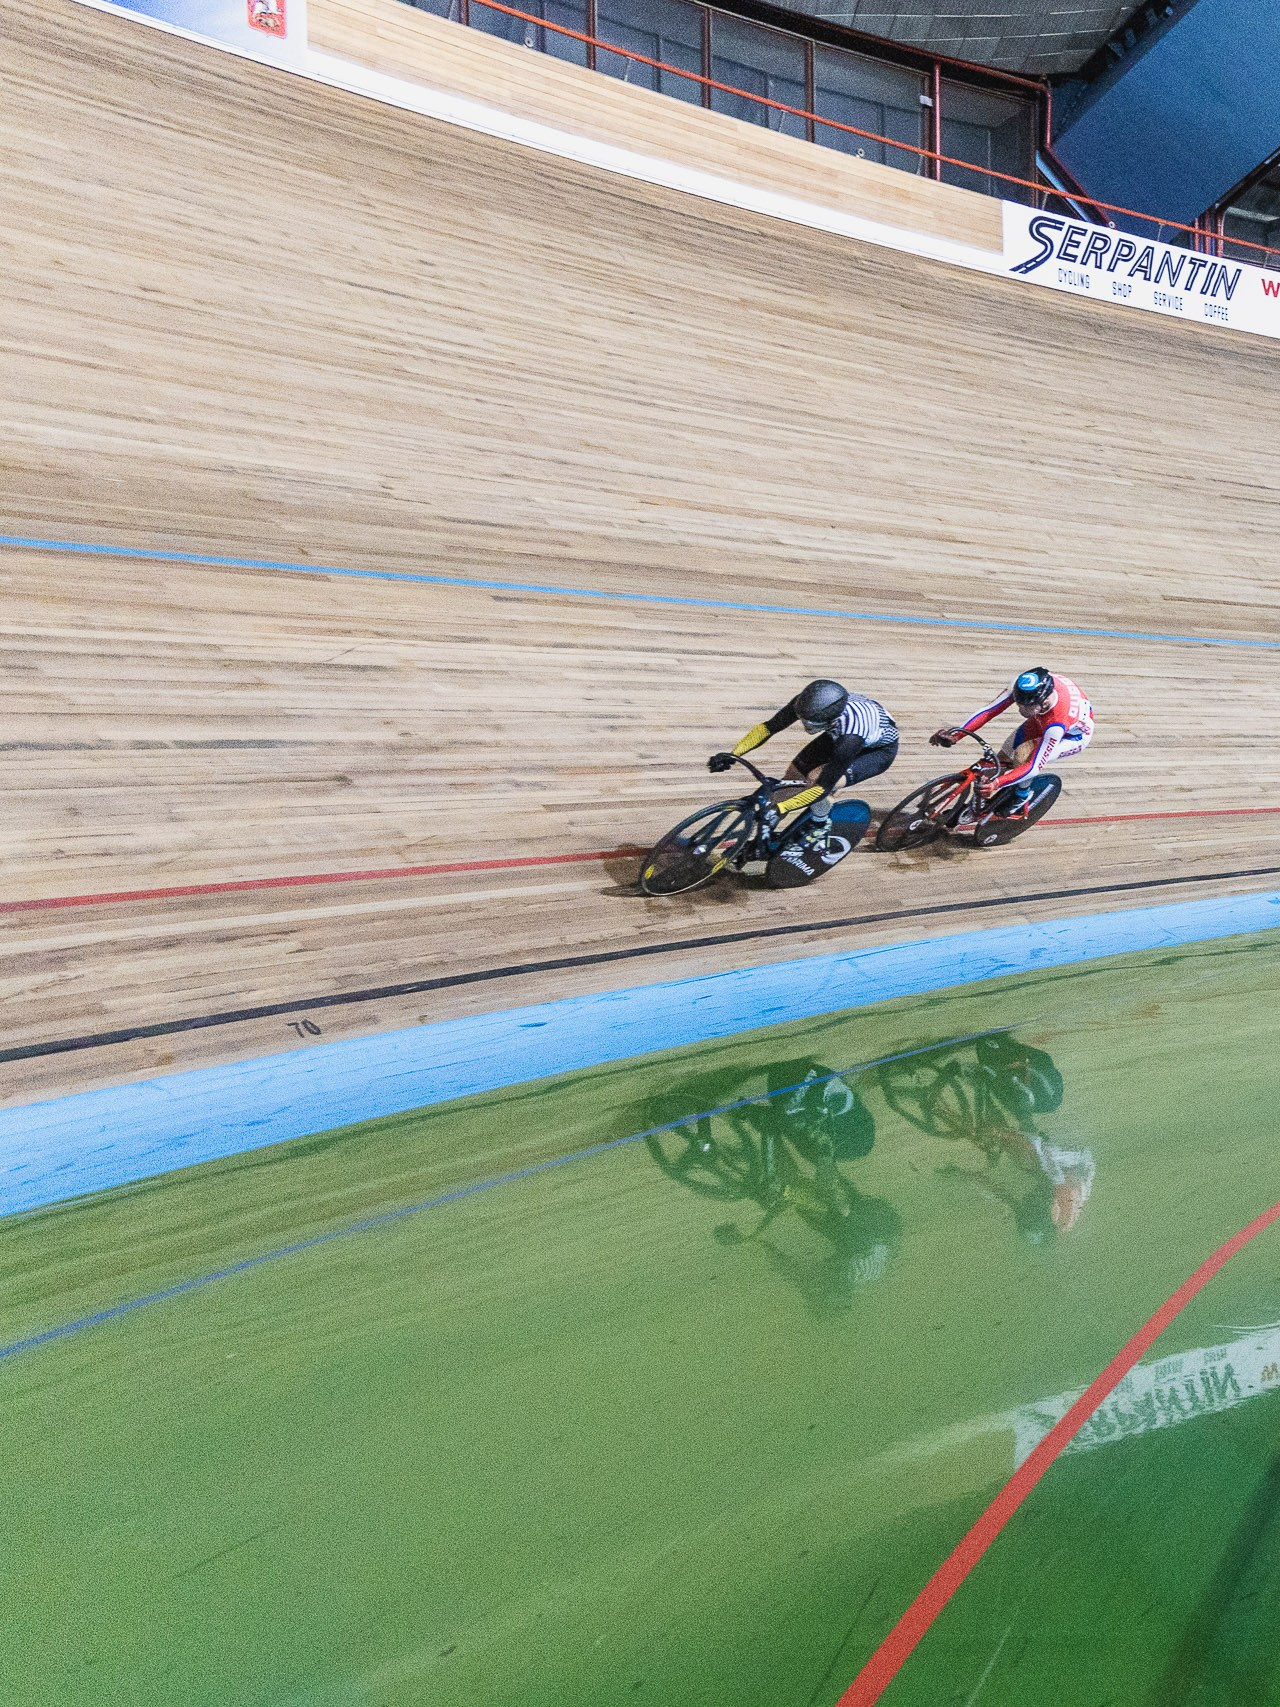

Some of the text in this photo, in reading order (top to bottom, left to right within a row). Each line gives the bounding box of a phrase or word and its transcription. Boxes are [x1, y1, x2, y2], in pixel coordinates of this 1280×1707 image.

[1008, 215, 1242, 300] SERPANTIN
[1058, 268, 1229, 321] CYCLING SHOP SERVICE COFFEE
[287, 1019, 321, 1038] 70
